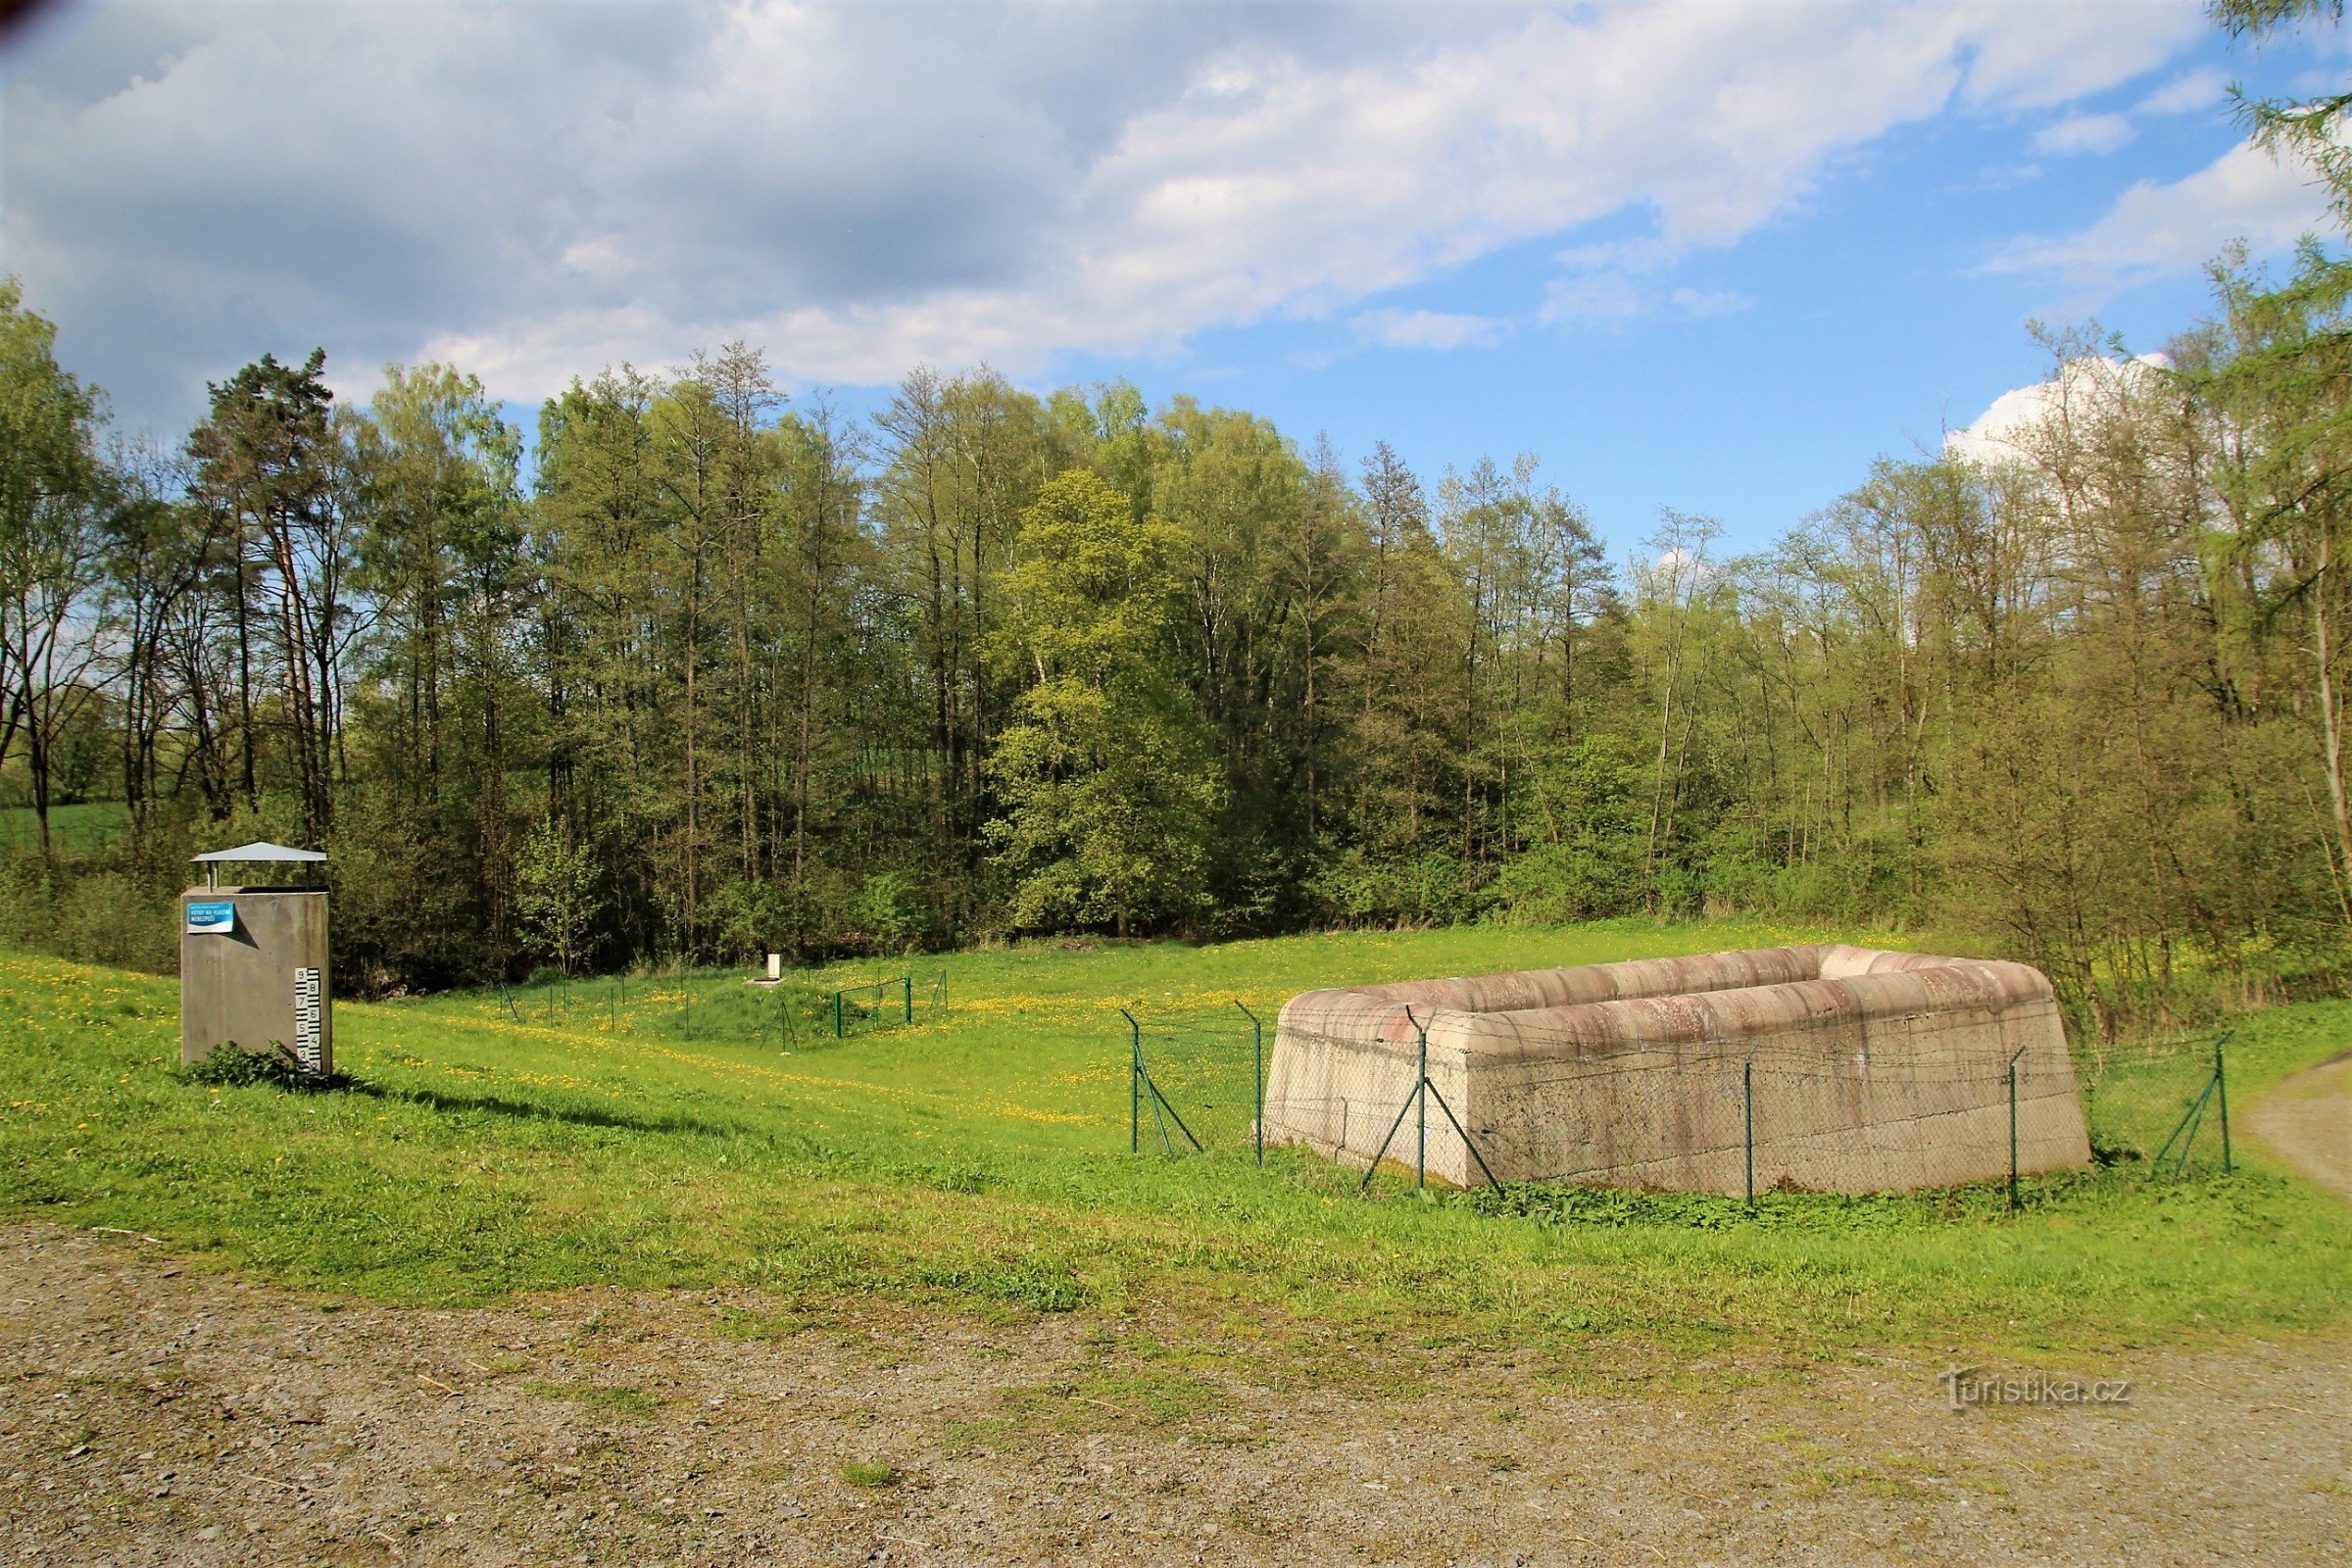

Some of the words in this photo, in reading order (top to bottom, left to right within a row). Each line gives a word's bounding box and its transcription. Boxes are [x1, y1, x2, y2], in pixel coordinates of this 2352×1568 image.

[298, 970, 304, 979] 9
[310, 983, 316, 992] 8
[299, 997, 305, 1005] 7
[311, 1009, 317, 1018] 6
[299, 1023, 305, 1032] 5
[311, 1036, 317, 1045] 4
[300, 1050, 306, 1058] 3
